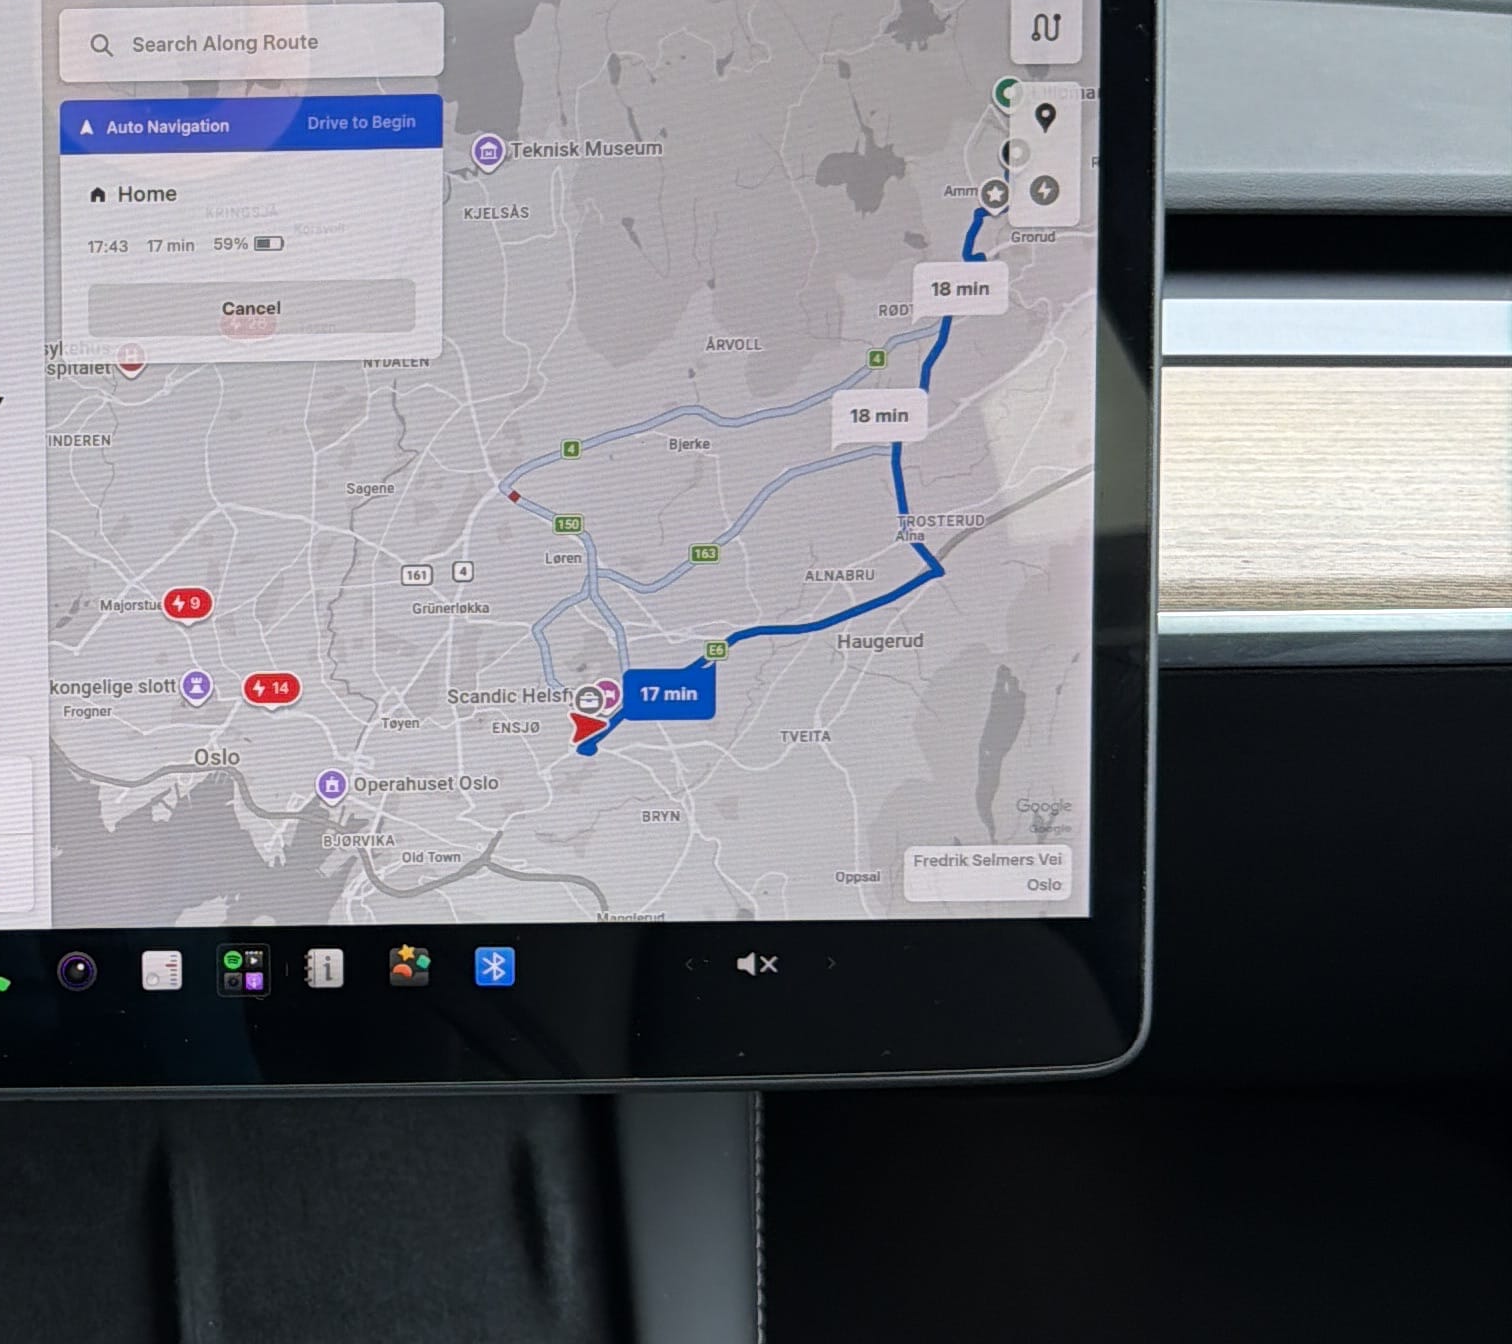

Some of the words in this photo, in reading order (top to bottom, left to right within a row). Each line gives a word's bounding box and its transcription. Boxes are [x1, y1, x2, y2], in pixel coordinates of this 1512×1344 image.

[132, 35, 197, 53] Search
[203, 34, 257, 55] Along
[263, 34, 319, 51] Route
[106, 119, 144, 135] Auto
[148, 118, 230, 137] Navigation
[307, 115, 349, 131] Drive
[352, 116, 368, 130] to
[372, 114, 416, 133] Begin
[512, 142, 579, 158] Teknisk
[585, 141, 663, 156] Museum
[118, 186, 177, 203] Home
[464, 205, 529, 220] KJELSÅS
[213, 236, 249, 251] 59%
[1011, 231, 1056, 244] Grorud
[88, 240, 129, 254] 17:43
[147, 240, 163, 253] 17
[167, 238, 195, 253] min
[931, 282, 951, 296] 18
[956, 281, 990, 295] min
[222, 301, 281, 316] Cancel
[706, 338, 763, 351] ÅRVOLL
[363, 358, 430, 368] NYDALEN
[872, 354, 882, 364] 4
[850, 410, 871, 423] 18
[875, 409, 909, 422] min
[46, 434, 111, 447] INDEREN
[669, 439, 710, 452] Bjerke
[567, 445, 575, 454] 4
[346, 483, 395, 497] Sagene
[558, 519, 579, 529] 150
[897, 515, 985, 528] TROSTERUD
[895, 530, 925, 542] Alna
[545, 552, 582, 564] Løren
[694, 548, 716, 559] 163
[406, 570, 428, 581] 161
[459, 566, 467, 577] 4
[805, 569, 875, 582] ALNABRU
[190, 596, 201, 610] 9
[837, 633, 924, 652] Haugerud
[709, 644, 724, 656] E6
[49, 680, 134, 698] kongelige
[138, 678, 177, 693] slott
[273, 682, 289, 695] 14
[640, 687, 658, 701] 17
[663, 687, 698, 700] min
[447, 688, 517, 704] Scandic
[63, 706, 112, 720] Frogner
[381, 717, 420, 731] Tøyen
[492, 721, 540, 734] ENSJØ
[780, 730, 831, 742] TVEITA
[194, 748, 240, 766] Oslo
[354, 777, 454, 793] Operahuset
[459, 775, 499, 791] Oslo
[1016, 798, 1072, 816] Google
[642, 810, 681, 823] BRYN
[323, 834, 395, 848] BJØRVIKA
[402, 851, 425, 863] Old
[429, 851, 461, 863] Town
[913, 853, 969, 868] Fredrik
[972, 852, 1034, 867] Selmers
[1038, 852, 1062, 866] Vei
[835, 870, 881, 884] Oppsal
[1027, 878, 1062, 892] Oslo
